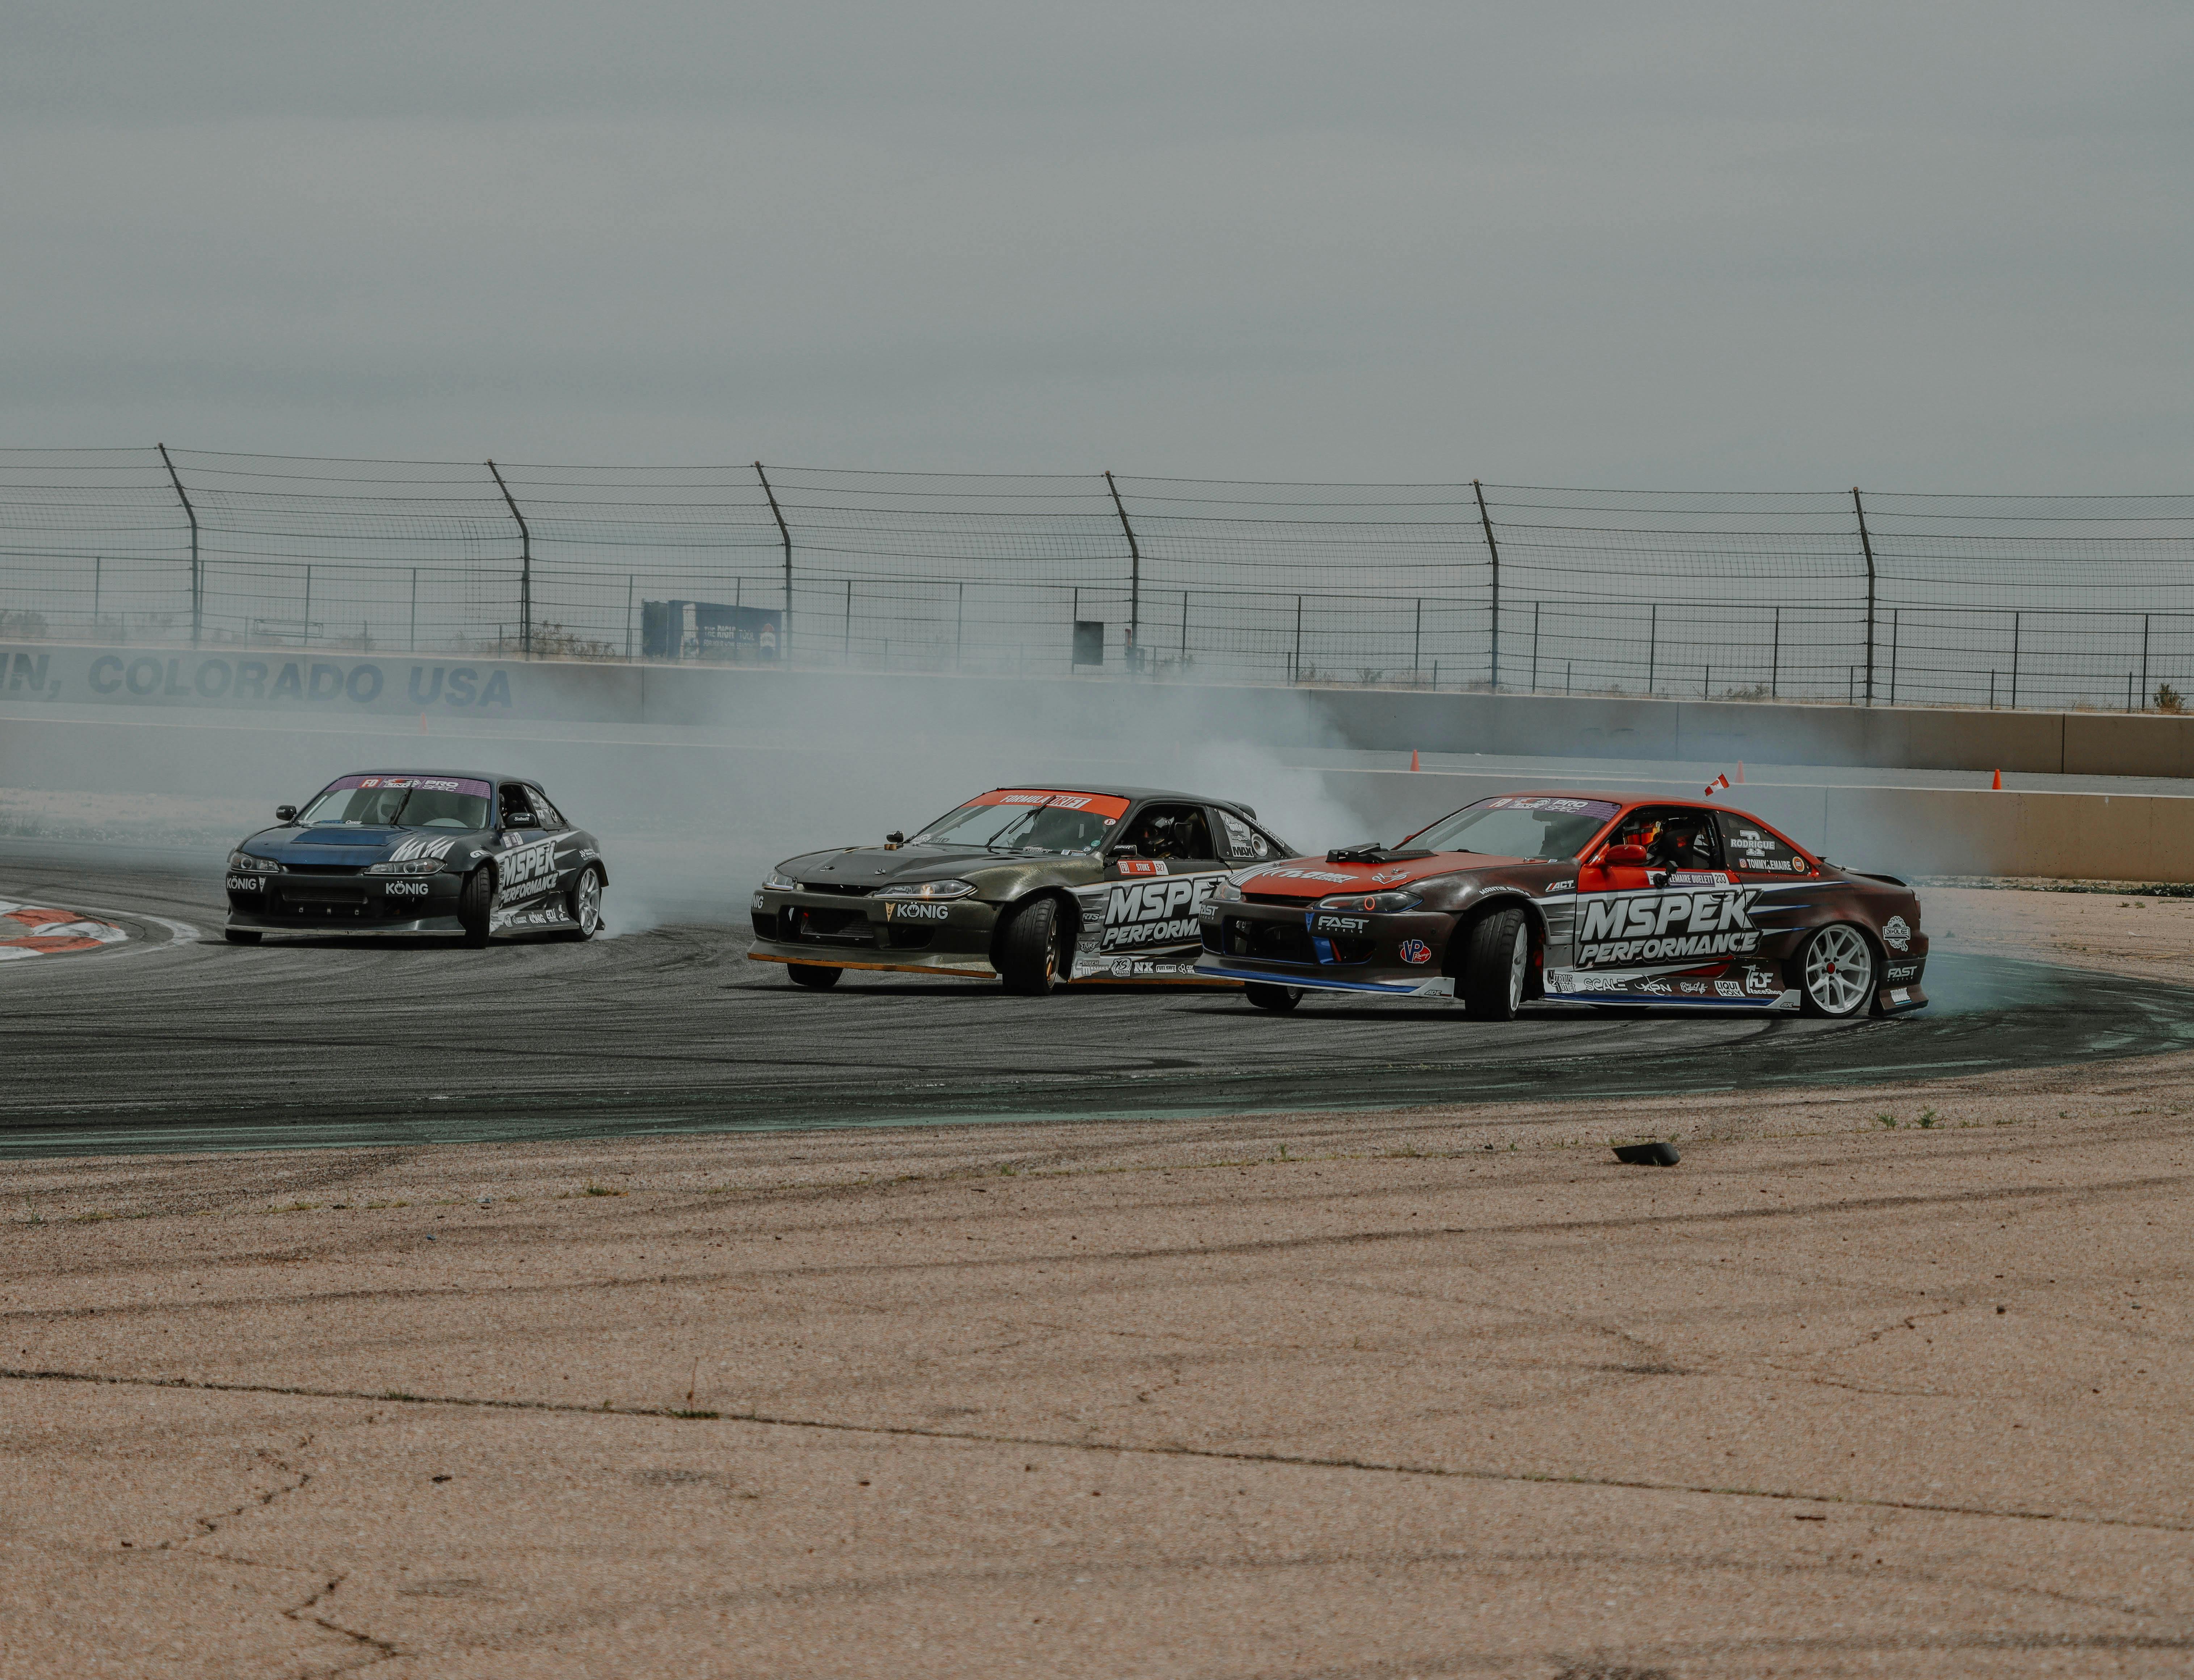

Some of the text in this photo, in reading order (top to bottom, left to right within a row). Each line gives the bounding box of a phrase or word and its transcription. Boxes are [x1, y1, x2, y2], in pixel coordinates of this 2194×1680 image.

[89, 655, 384, 703] COLORADO
[408, 666, 512, 708] USA
[999, 795, 1090, 808] FORMULA DRIFT
[1553, 799, 1589, 808] PRO
[1731, 839, 1775, 850] RODRIGUE
[504, 842, 556, 887] MSPEK
[1135, 863, 1151, 872] STUKE
[227, 875, 256, 890] KÖNIG
[1552, 880, 1575, 890] ACT
[1669, 874, 1692, 883] LEMAIRE
[1715, 874, 1726, 883] 233
[386, 881, 429, 896] KÖNIG
[501, 873, 558, 904] PERFORMANCE
[1478, 886, 1507, 895] MANTIS
[1105, 878, 1226, 925] MSPE
[897, 902, 949, 920] KÖNIG
[1201, 905, 1219, 916] AST
[1580, 890, 1758, 942] MSPEK
[1318, 916, 1370, 929] FAST
[1403, 940, 1424, 962] VP
[1578, 931, 1761, 964] PERFORMANCE
[1076, 959, 1098, 969] CLUTCH
[1082, 966, 1109, 975] MASTERS
[1134, 962, 1154, 971] NX
[1547, 970, 1573, 984] NITROUS
[1887, 966, 1918, 978] FAST
[1584, 978, 1628, 991] SCALE
[1716, 982, 1738, 990] LIQUI
